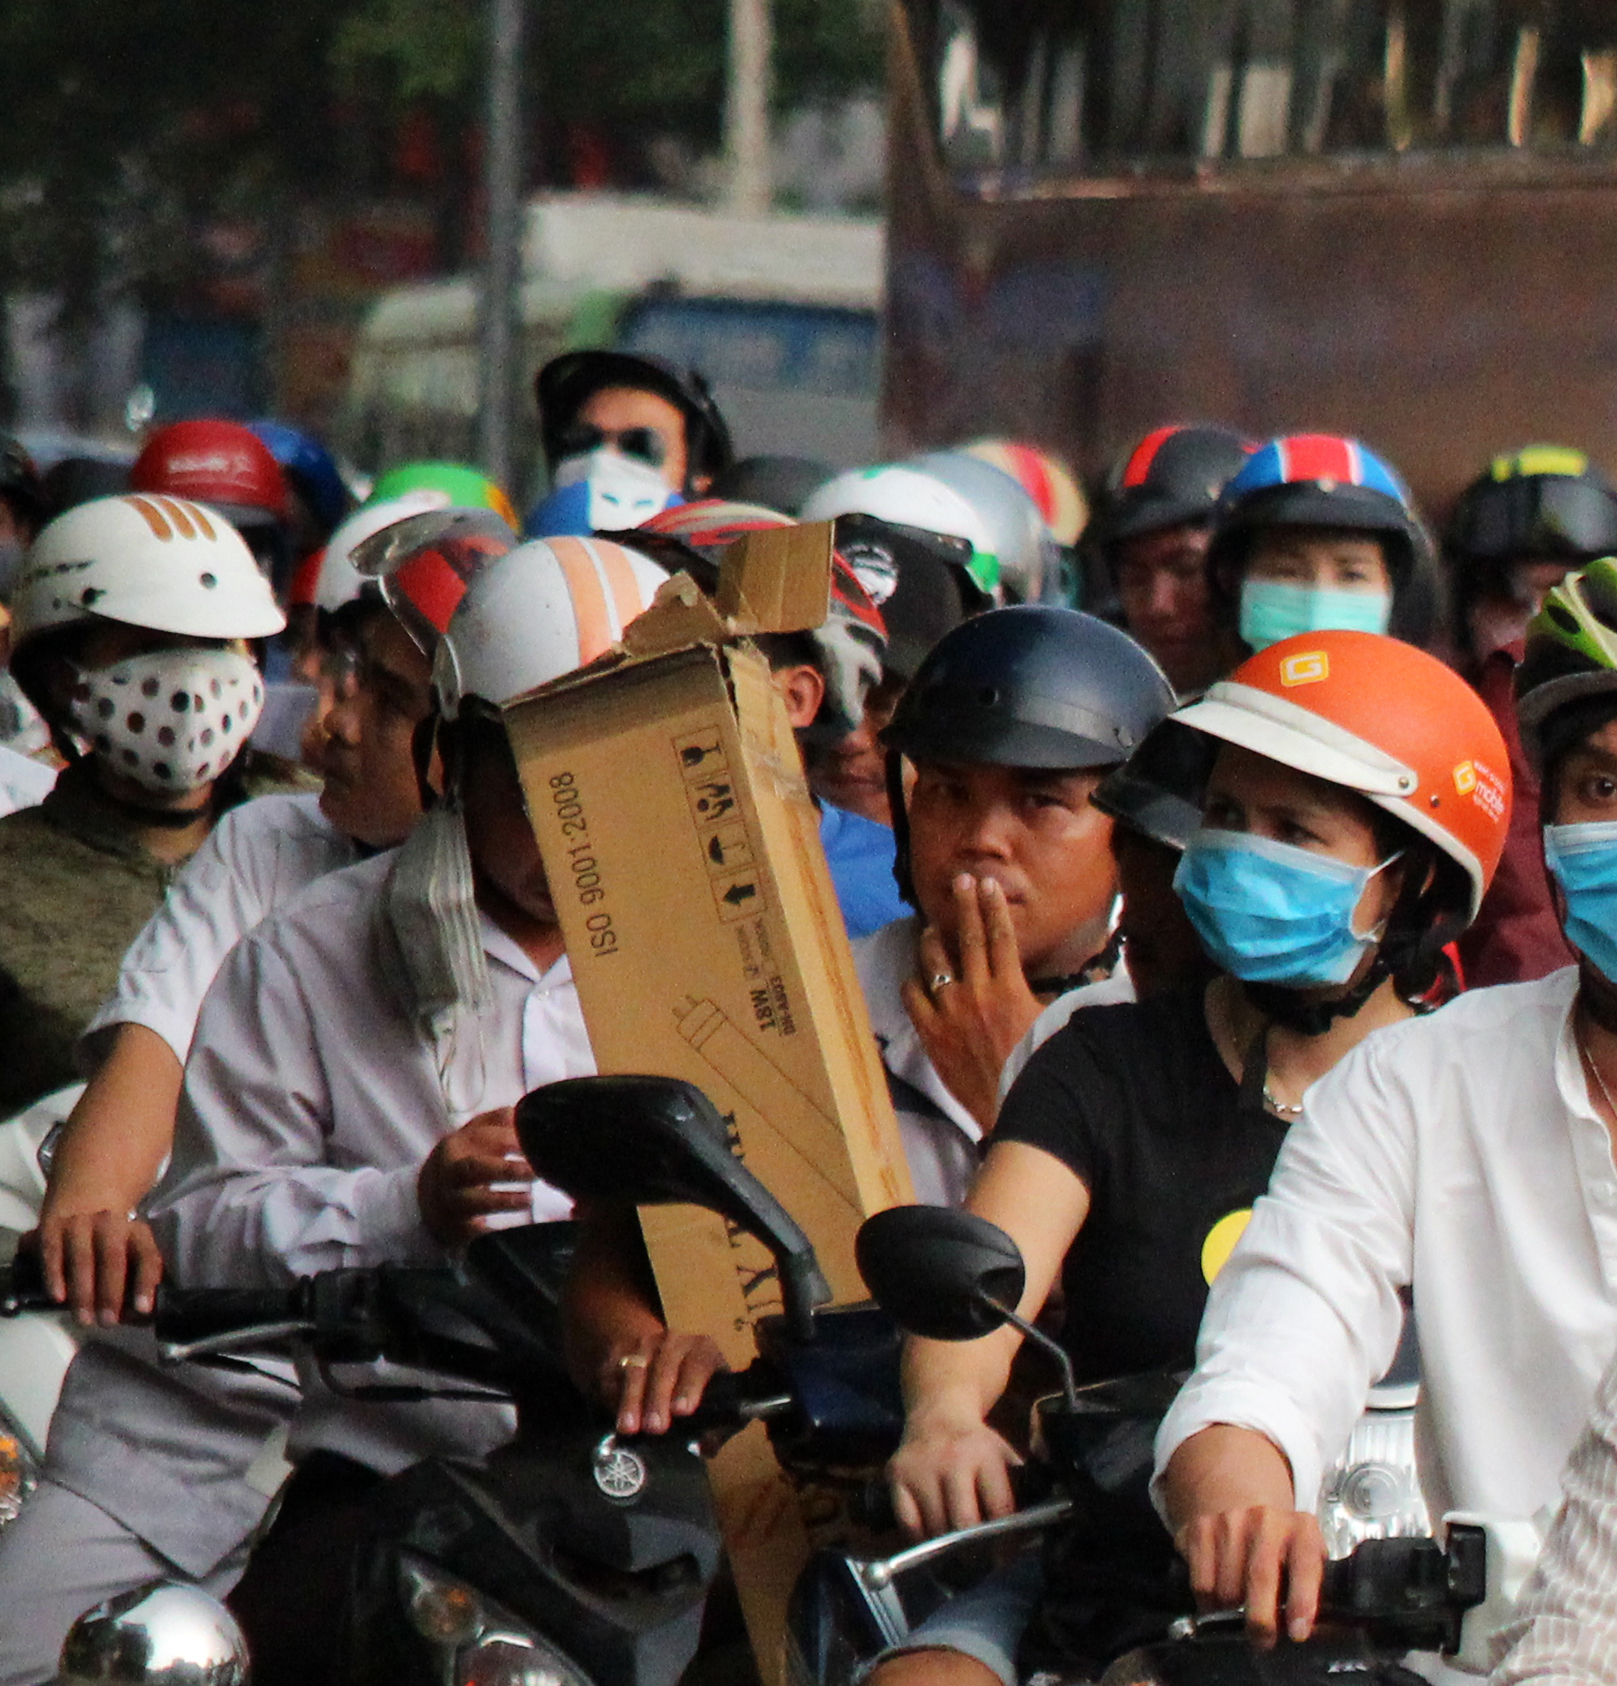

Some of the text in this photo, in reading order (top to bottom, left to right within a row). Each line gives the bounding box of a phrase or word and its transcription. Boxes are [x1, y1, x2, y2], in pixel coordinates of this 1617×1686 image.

[549, 771, 619, 957] ISO 9001:2008
[750, 989, 777, 1032] 18W
